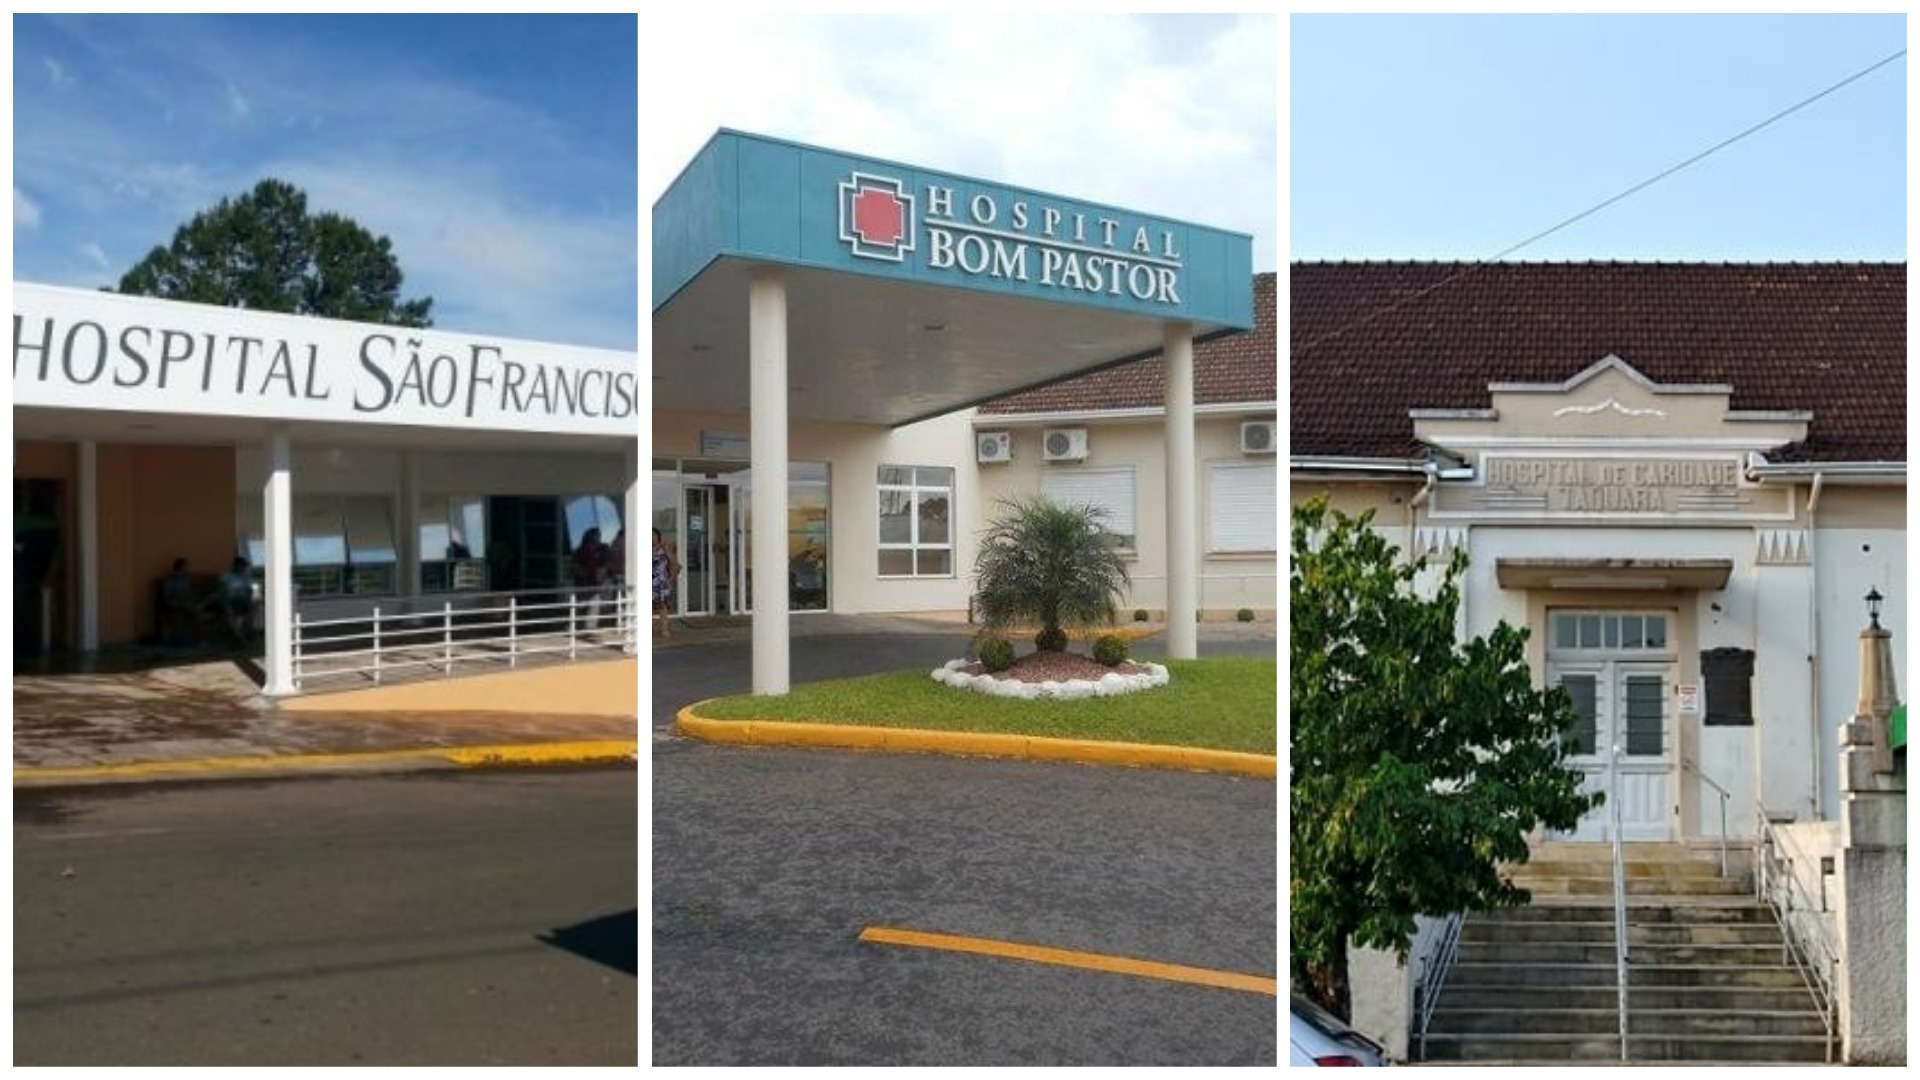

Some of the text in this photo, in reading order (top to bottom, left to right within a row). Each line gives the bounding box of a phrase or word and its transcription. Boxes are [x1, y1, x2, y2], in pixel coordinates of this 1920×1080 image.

[928, 185, 1180, 259] HOSPITAL
[929, 228, 1181, 304] BOM PASTOR
[13, 315, 329, 400] HOSPITAL
[465, 344, 638, 418] FRANCIS
[1487, 461, 1595, 487] HOSPITAL
[1634, 461, 1738, 487] CARIDADE
[1561, 488, 1666, 512] TAQUARA
